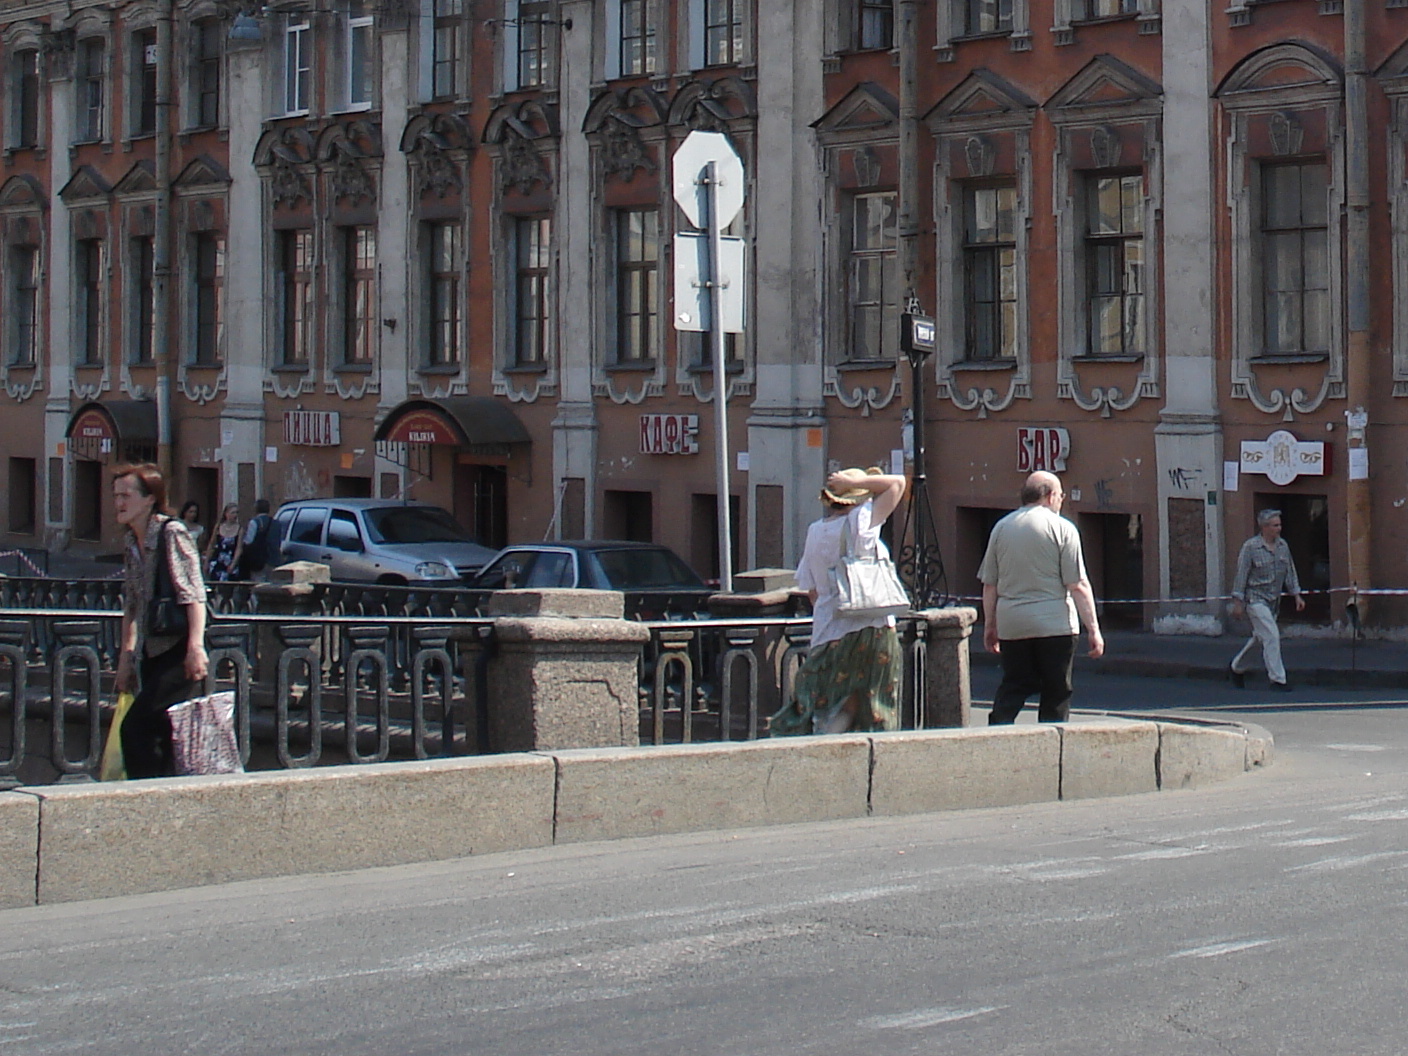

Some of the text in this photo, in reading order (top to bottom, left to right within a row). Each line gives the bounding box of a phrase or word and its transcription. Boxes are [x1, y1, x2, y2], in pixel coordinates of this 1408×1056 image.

[284, 412, 332, 444] ПИЦЦА
[640, 415, 691, 454] КАФЕ
[1017, 428, 1062, 472] БАР
